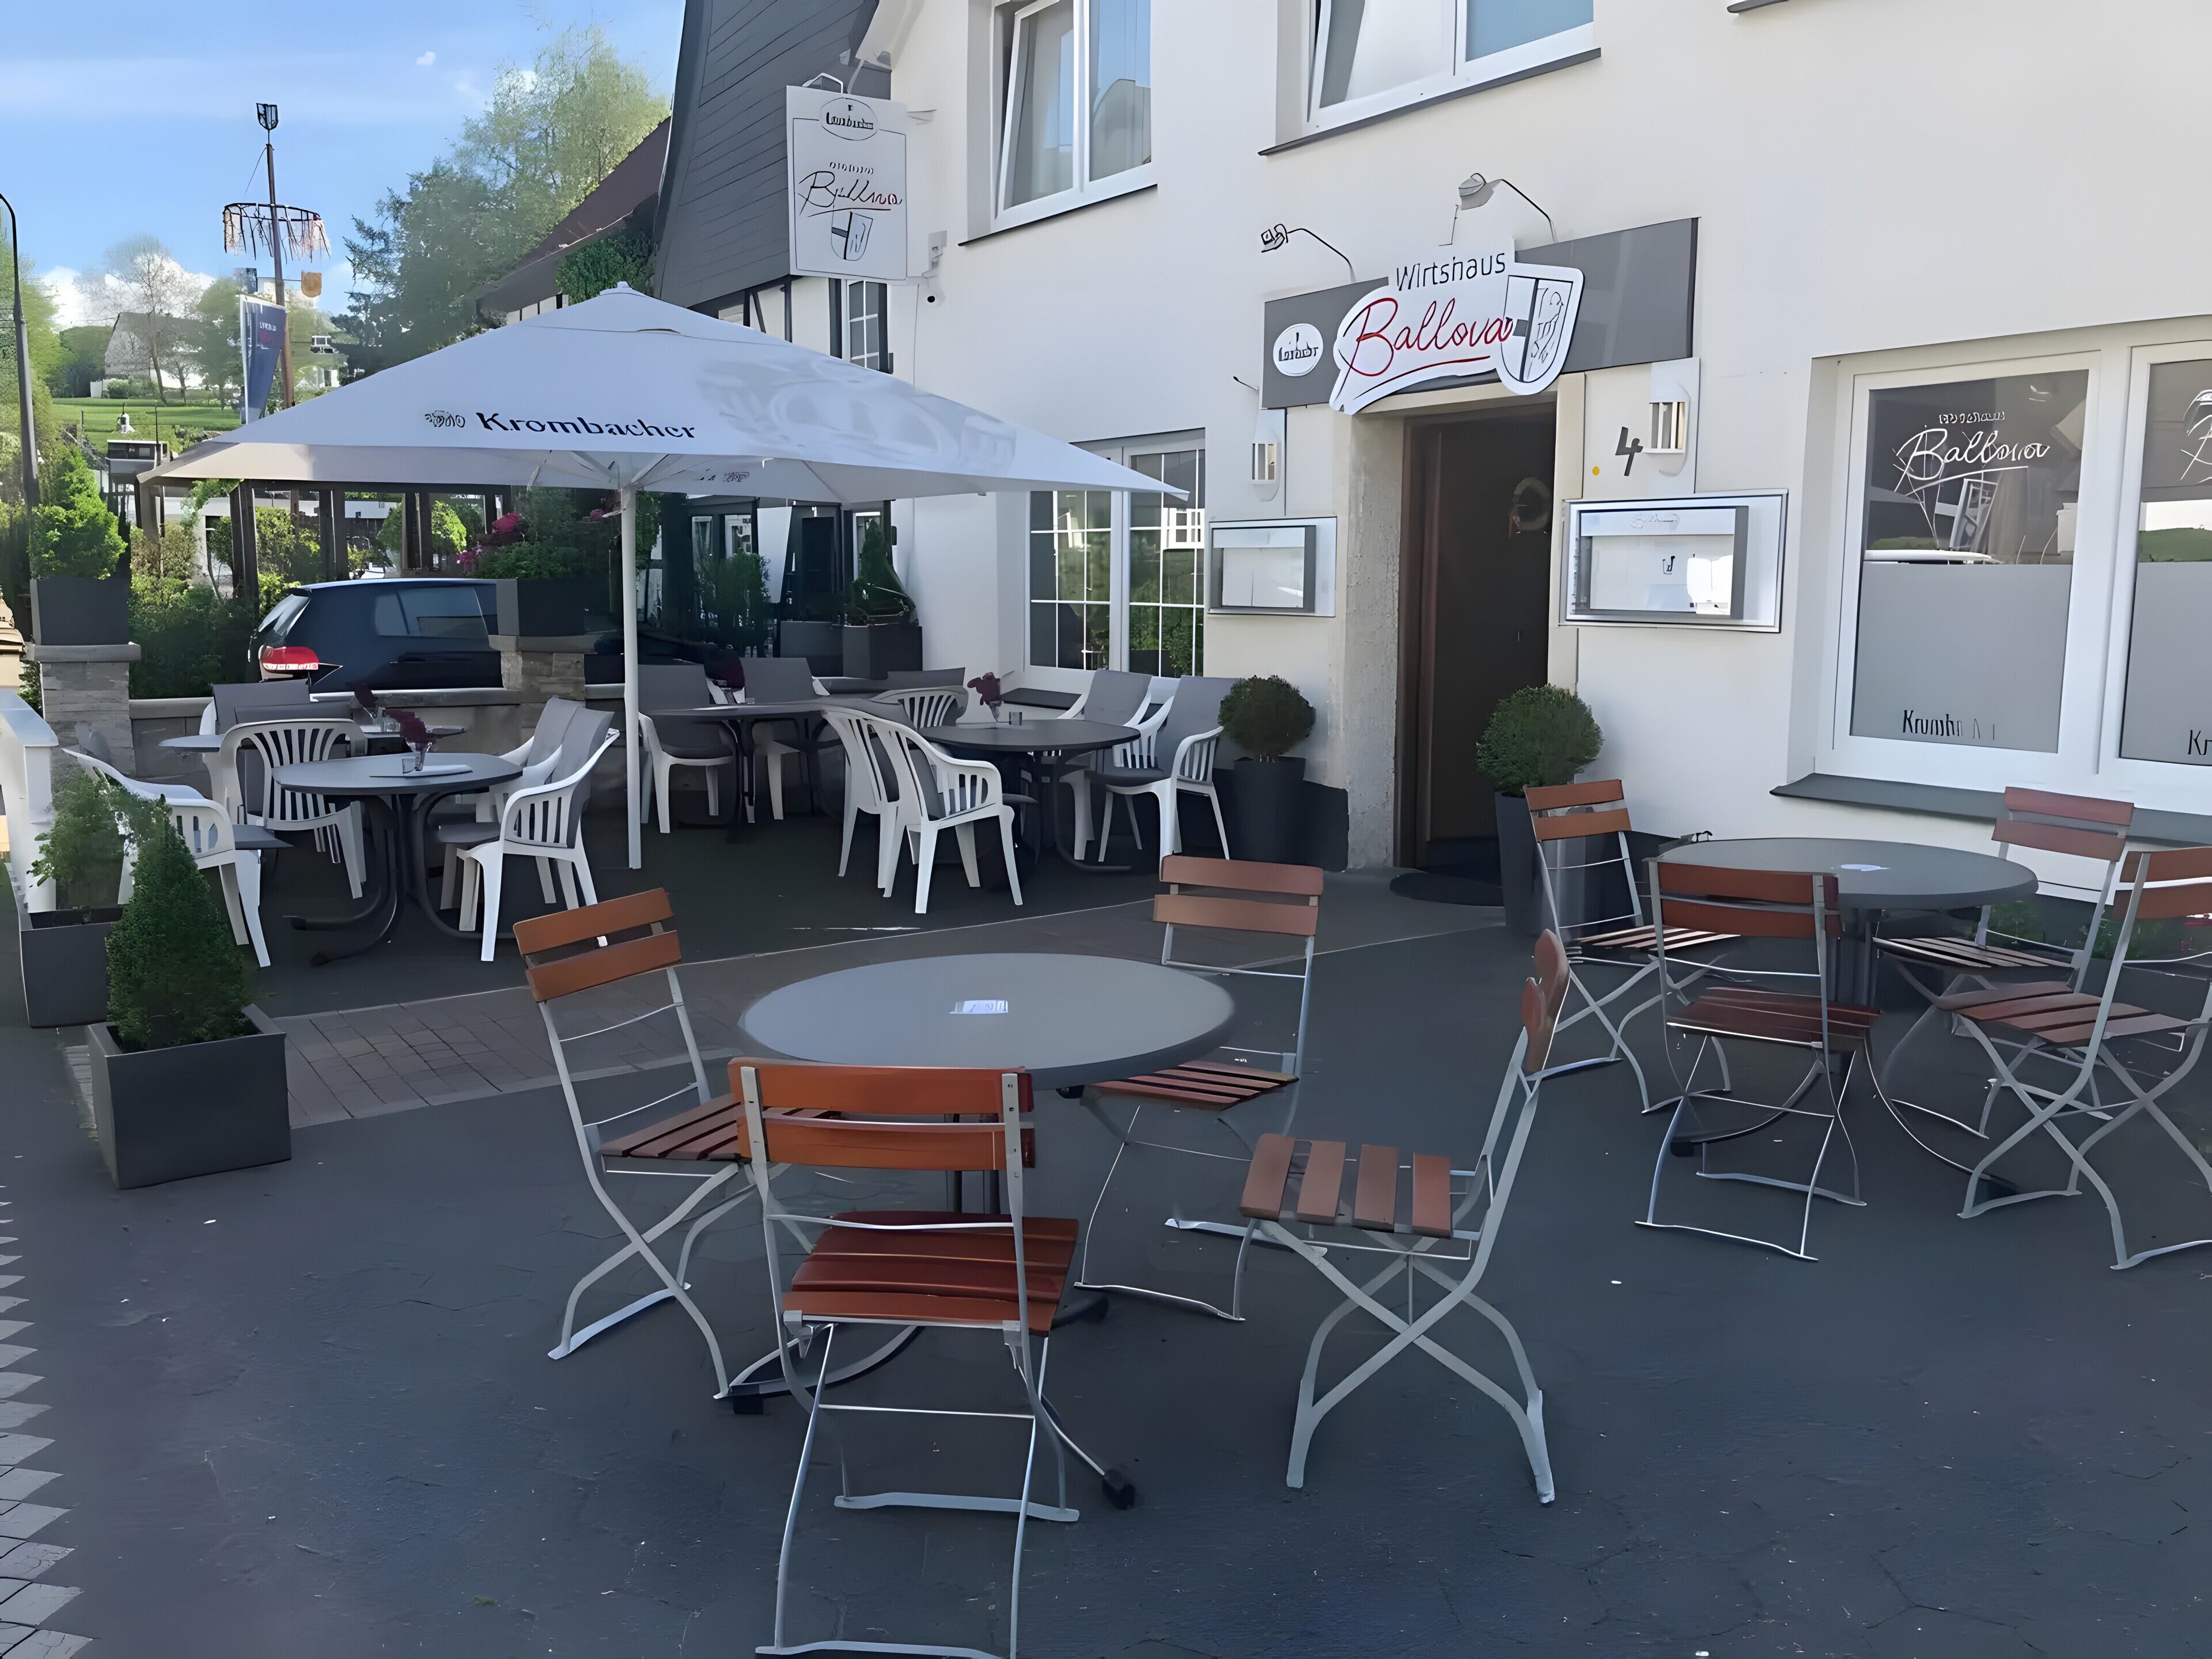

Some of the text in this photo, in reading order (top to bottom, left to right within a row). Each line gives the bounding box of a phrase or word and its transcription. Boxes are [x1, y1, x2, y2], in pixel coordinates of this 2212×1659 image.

[1396, 252, 1506, 291] Wirtshaus
[1334, 297, 1513, 402] Ballova
[476, 412, 695, 438] Krombacher
[1615, 427, 1643, 476] 4
